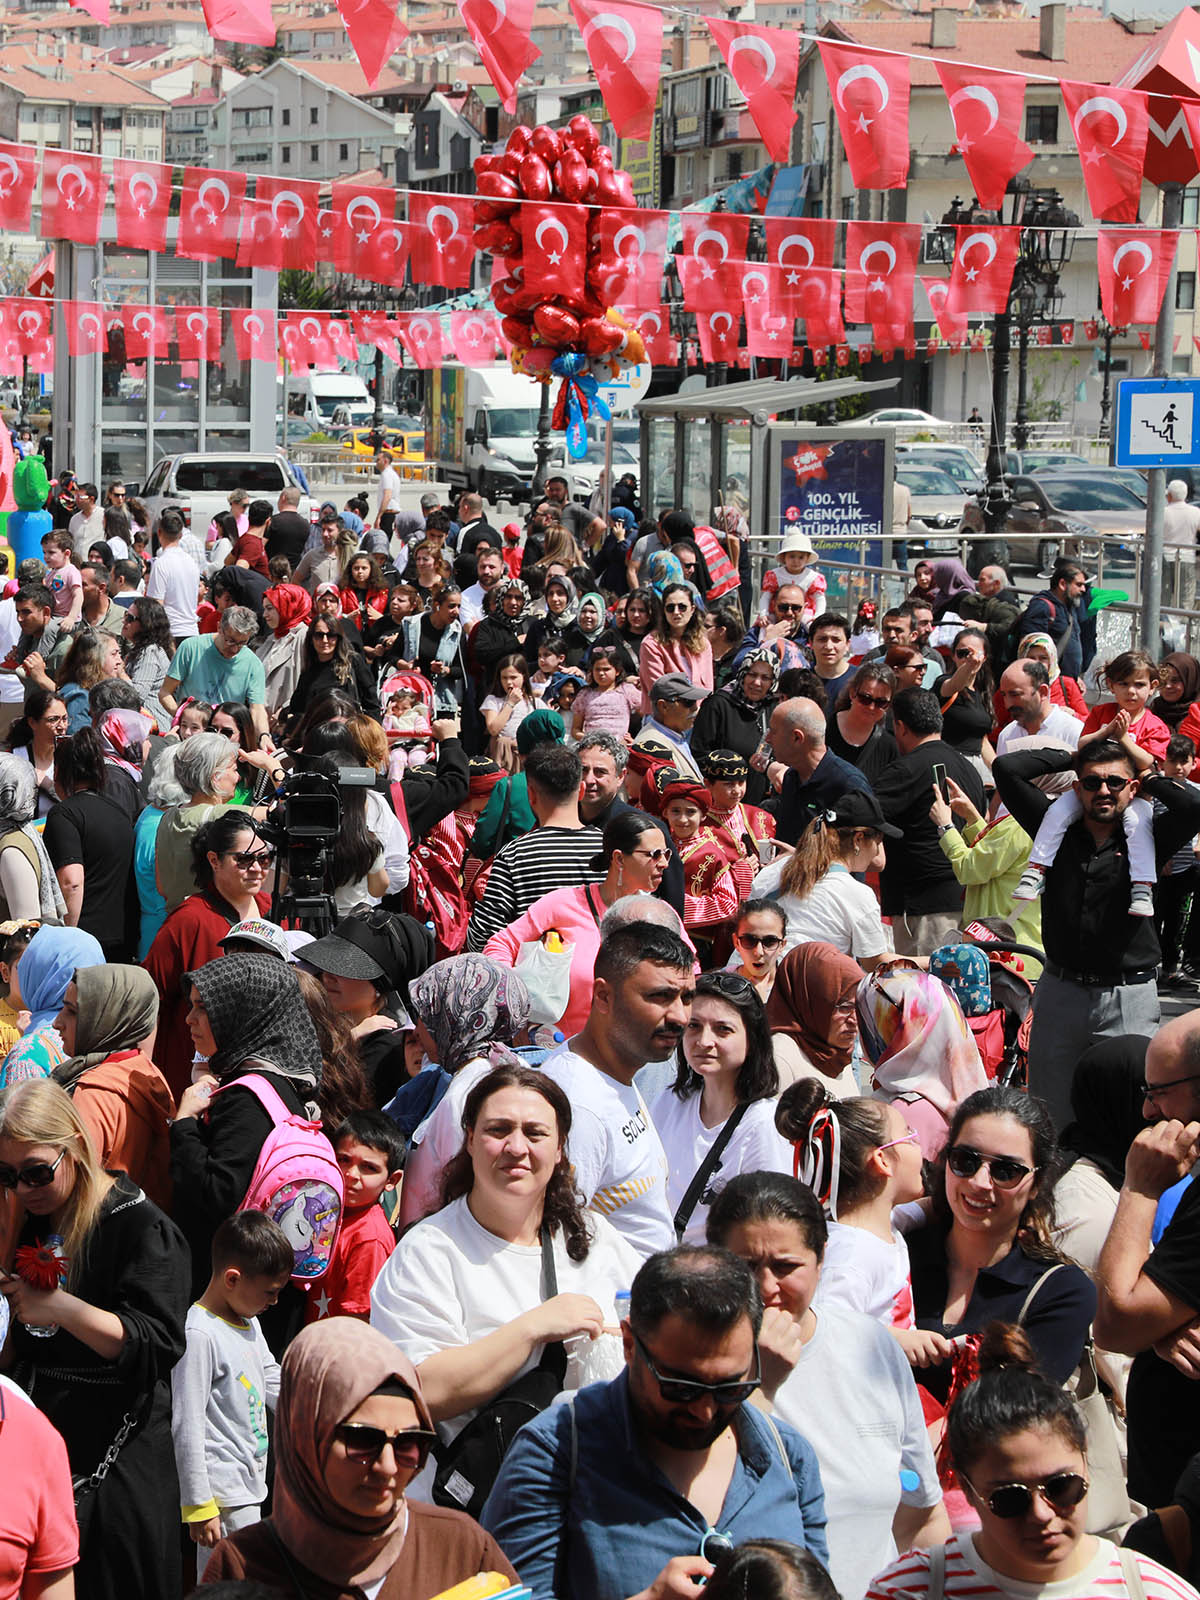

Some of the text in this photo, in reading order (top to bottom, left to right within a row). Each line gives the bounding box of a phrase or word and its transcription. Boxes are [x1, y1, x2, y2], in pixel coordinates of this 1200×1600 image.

[807, 491, 860, 505] 100. YIL
[803, 505, 863, 523] GENÇLİK
